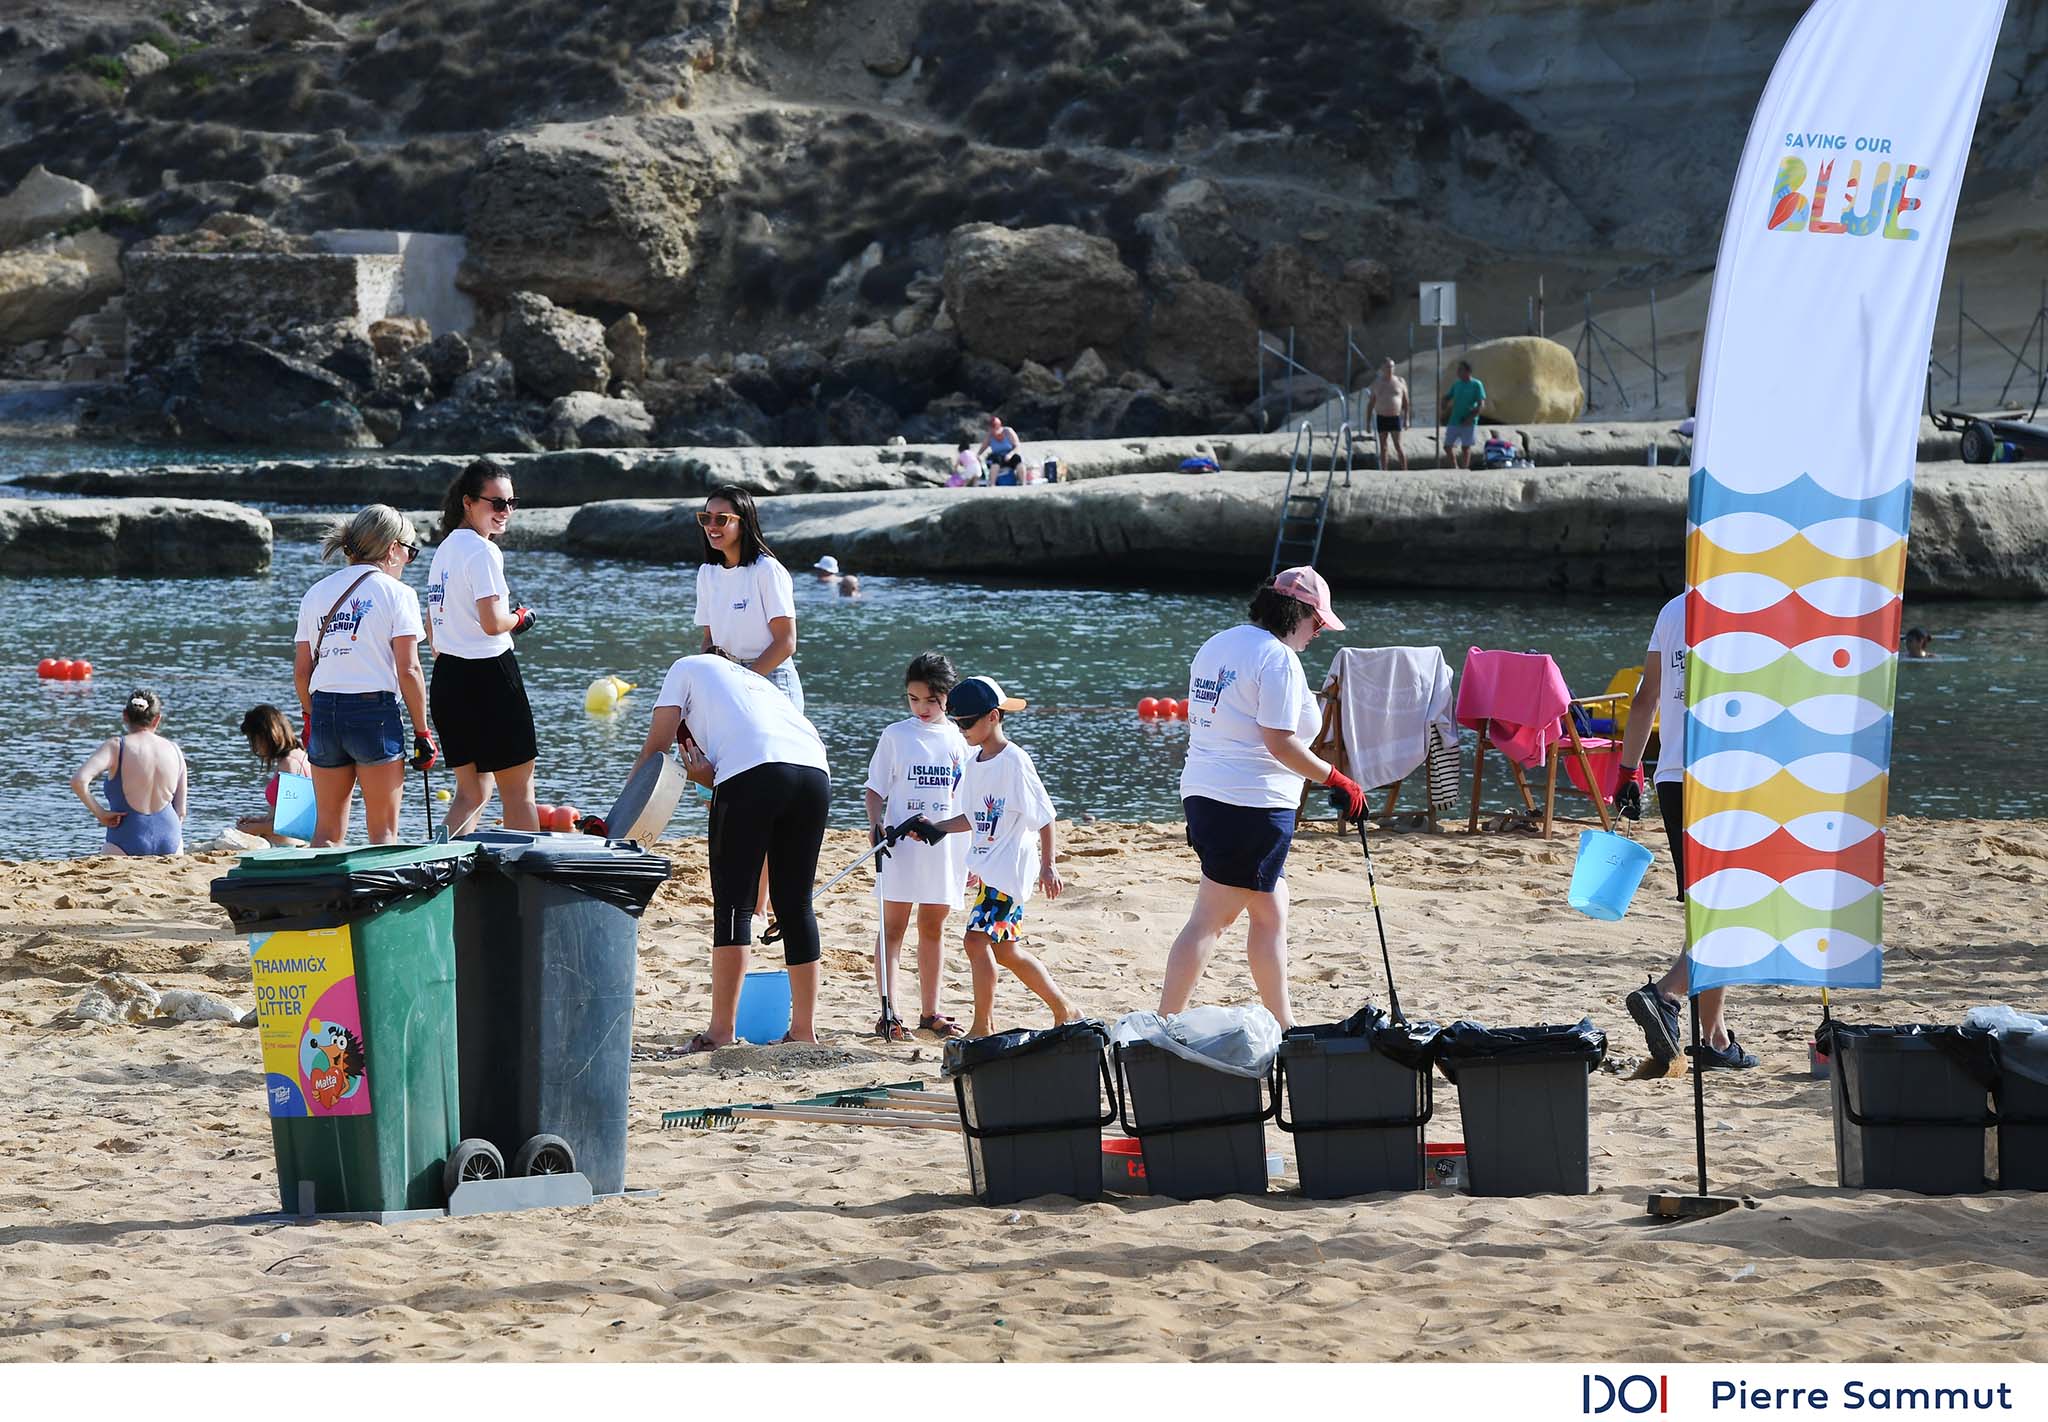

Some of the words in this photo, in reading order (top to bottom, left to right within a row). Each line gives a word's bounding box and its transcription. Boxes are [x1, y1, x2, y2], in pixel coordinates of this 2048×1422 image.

[1785, 133, 1847, 150] SAVING
[1855, 137, 1892, 154] OUR
[1767, 155, 1931, 241] BLUE
[913, 765, 951, 776] ISLANDS
[257, 986, 275, 1000] DO
[279, 985, 307, 1000] NOT
[259, 1000, 302, 1016] LITTER
[315, 1075, 337, 1090] Malta
